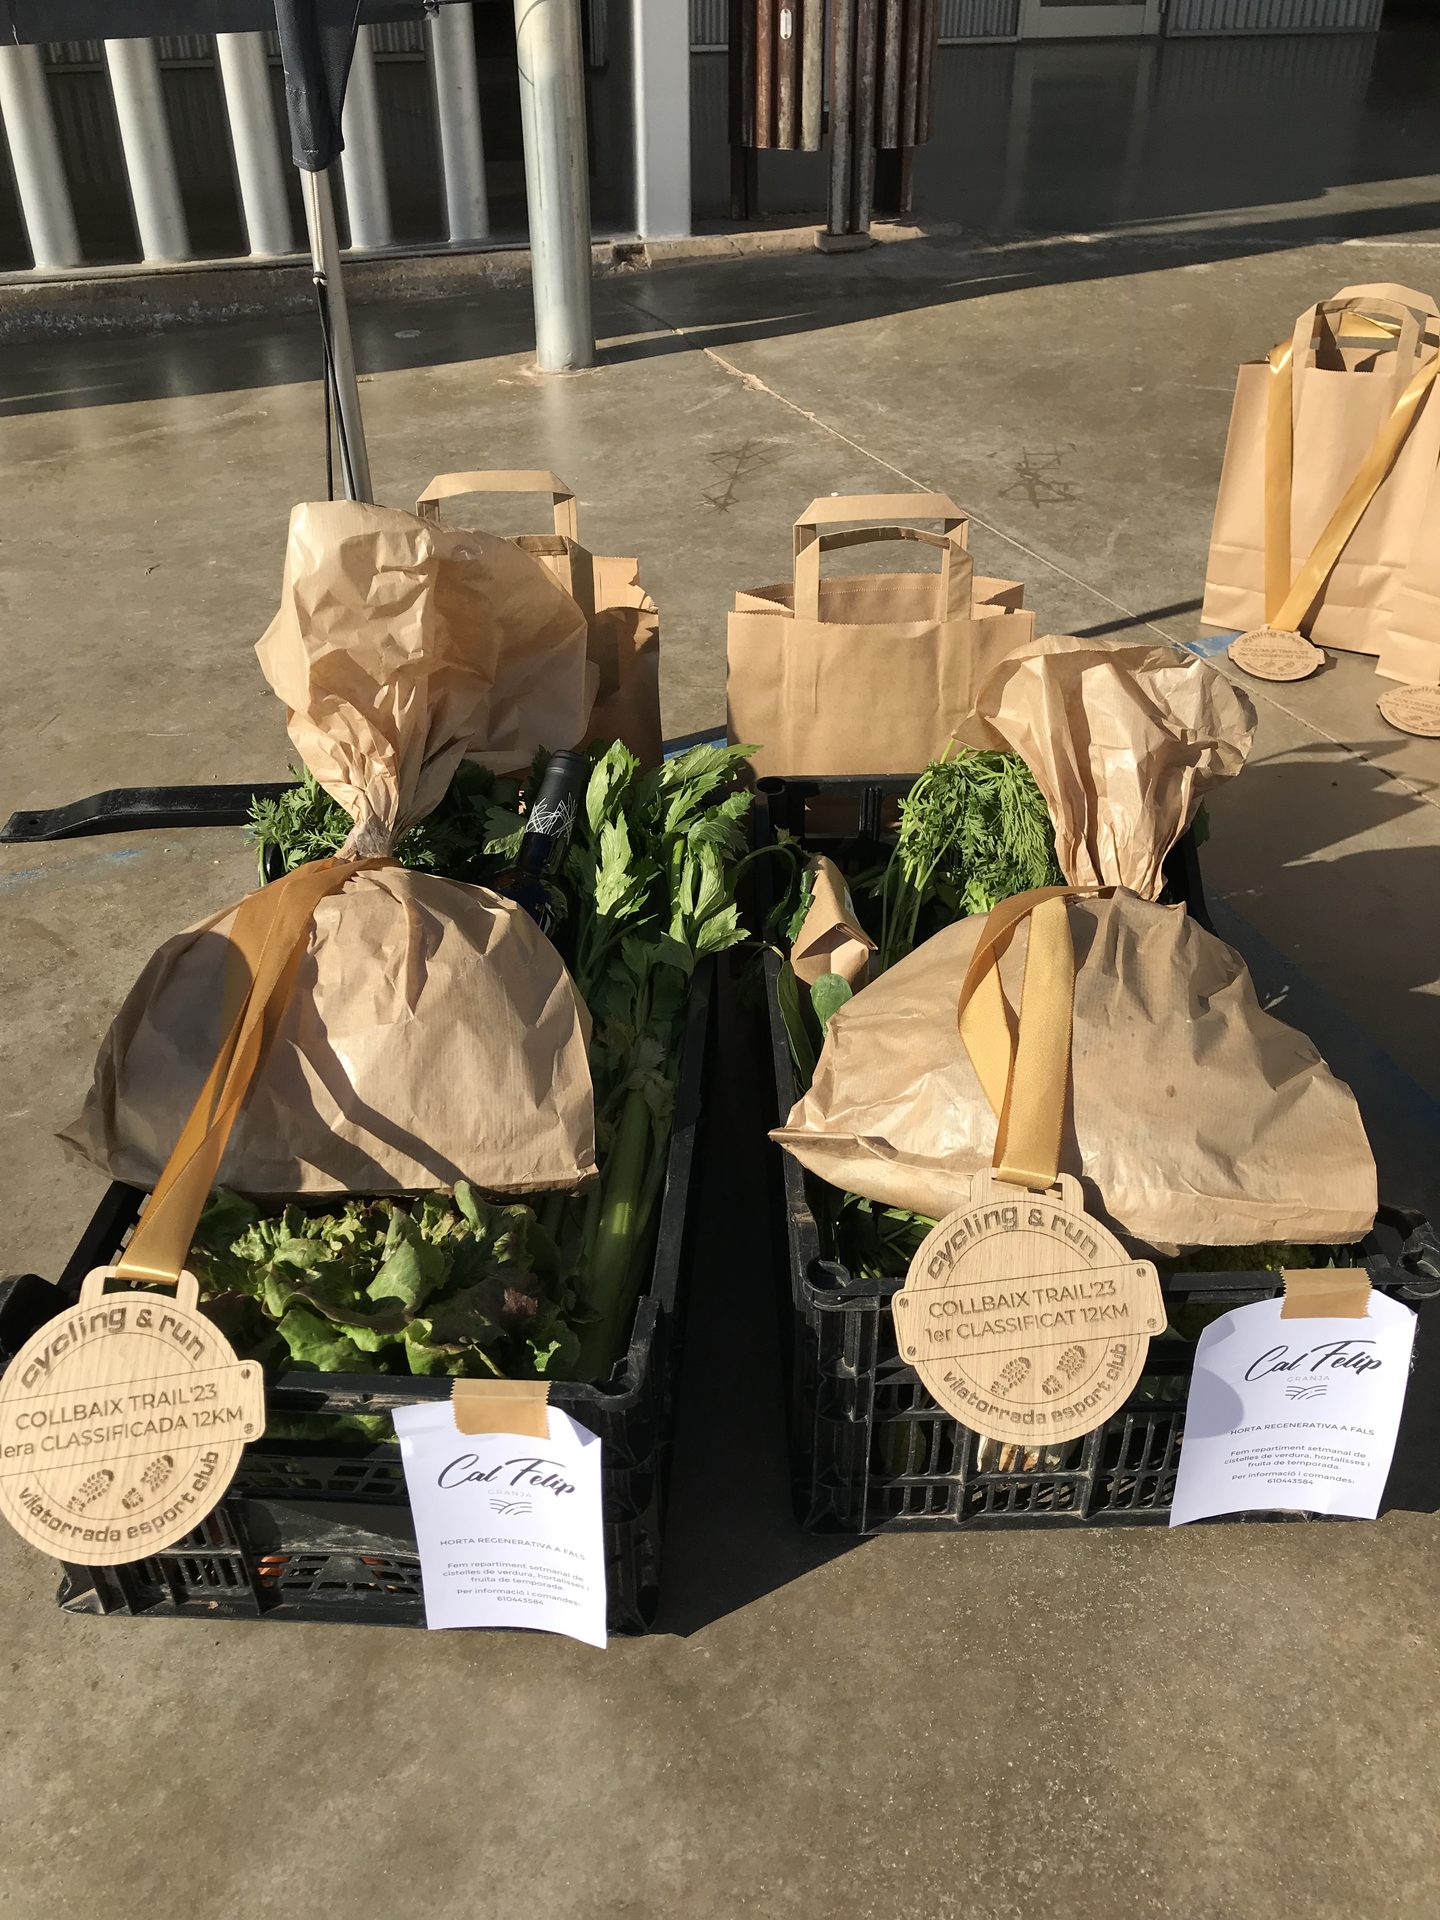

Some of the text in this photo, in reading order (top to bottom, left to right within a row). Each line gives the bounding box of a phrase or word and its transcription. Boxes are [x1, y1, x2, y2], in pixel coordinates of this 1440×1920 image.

[927, 1206, 1099, 1280] cycling & run
[928, 1279, 1116, 1319] COLLBAIX TRAIL'23
[925, 1303, 1129, 1344] 1er CLASSIFICAT 12KM
[20, 1306, 207, 1390] cycling & run
[1244, 1340, 1383, 1382] Cal Felip
[943, 1342, 1128, 1425] vilatorrada esport club
[1286, 1374, 1331, 1383] GRANJA
[16, 1383, 218, 1431] COLLBAIX TRAIL'23
[40, 1414, 189, 1453] CLASSIFICADA
[192, 1405, 244, 1429] 12KM
[1230, 1424, 1263, 1436] HORTA
[1350, 1426, 1375, 1436] FALS
[1224, 1455, 1259, 1465] cistelles
[1251, 1445, 1305, 1454] repartiment
[1307, 1445, 1352, 1456] setmanal
[1353, 1451, 1367, 1459] de
[437, 1453, 576, 1497] Cal Felip
[18, 1451, 219, 1542] vilatorrada esport club
[440, 1538, 475, 1547] HORTA
[563, 1548, 586, 1560] FALS
[442, 1568, 481, 1577] cistelles
[470, 1560, 527, 1570] repartiment
[529, 1563, 571, 1578] setmanal
[572, 1574, 585, 1582] de
